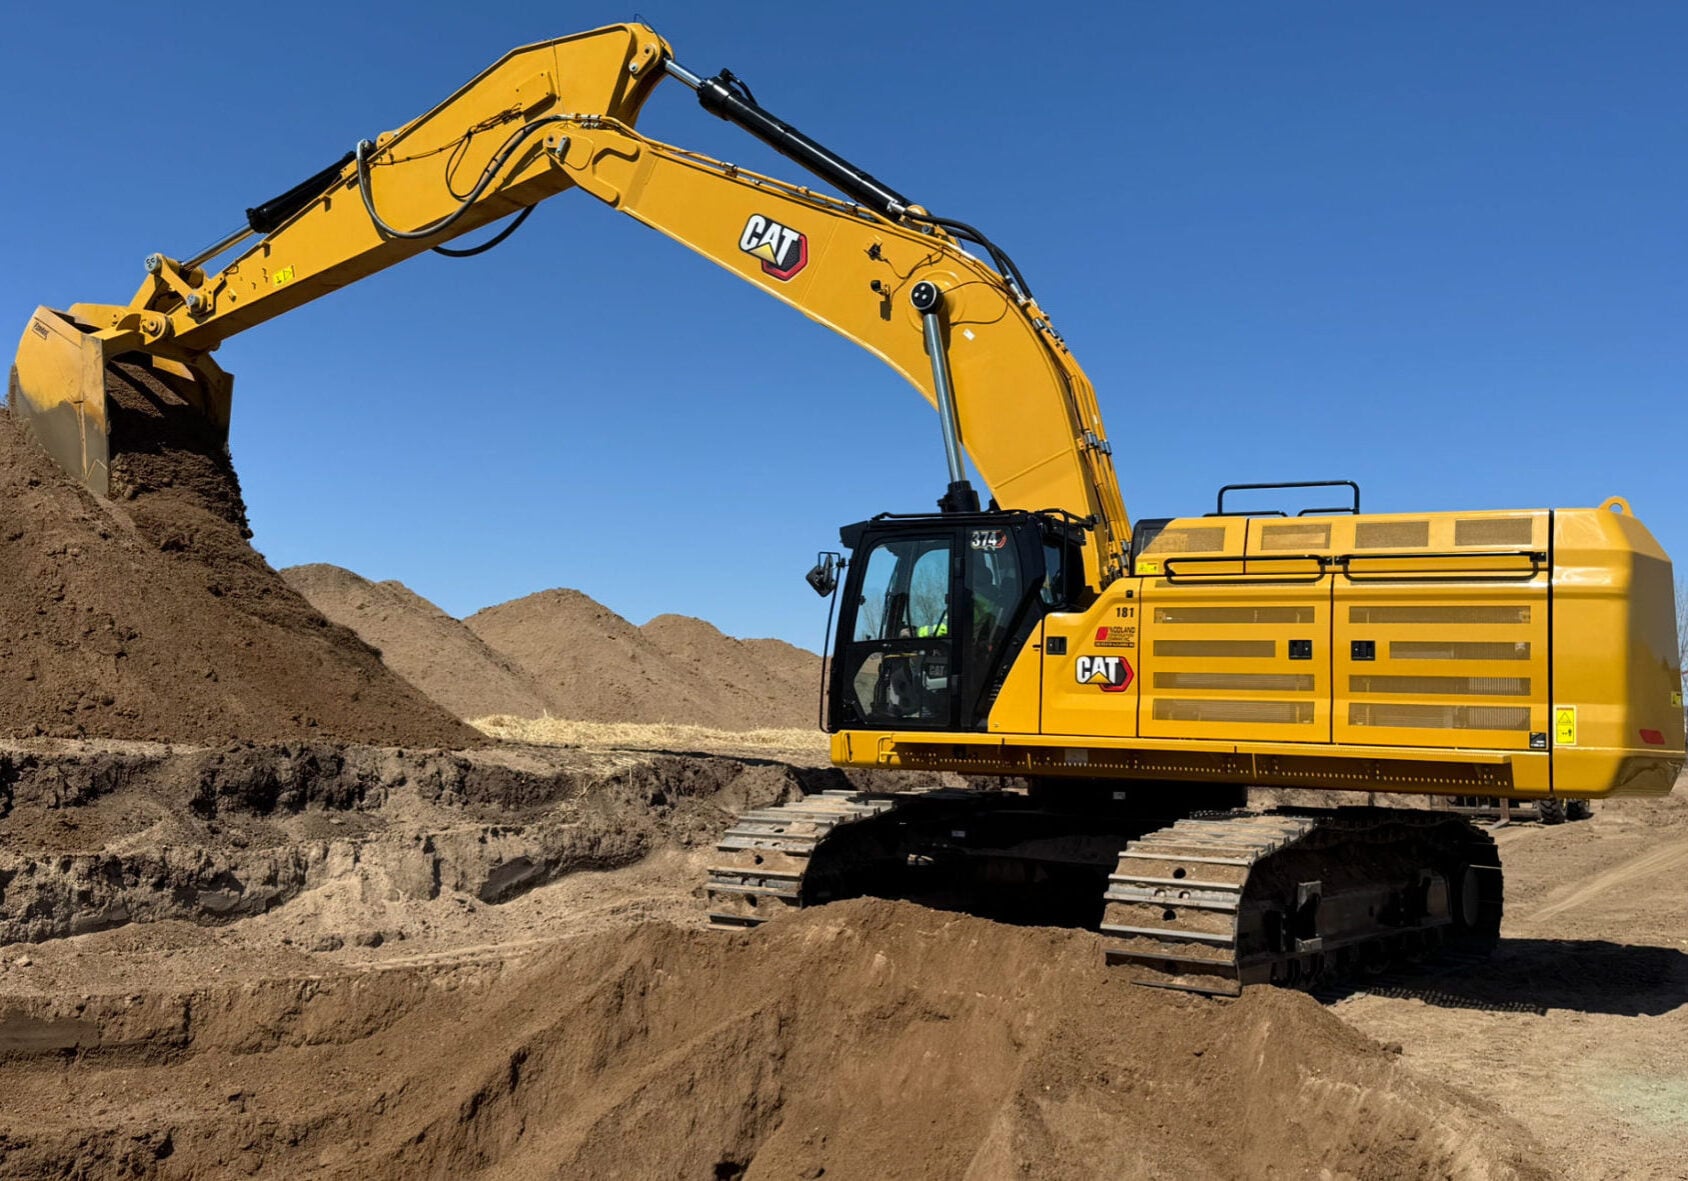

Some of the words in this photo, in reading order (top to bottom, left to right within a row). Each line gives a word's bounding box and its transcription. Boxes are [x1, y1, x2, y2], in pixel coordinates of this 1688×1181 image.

[740, 214, 800, 266] CAT
[971, 530, 997, 547] 374
[1116, 607, 1134, 618] 181
[1076, 656, 1120, 684] CAT
